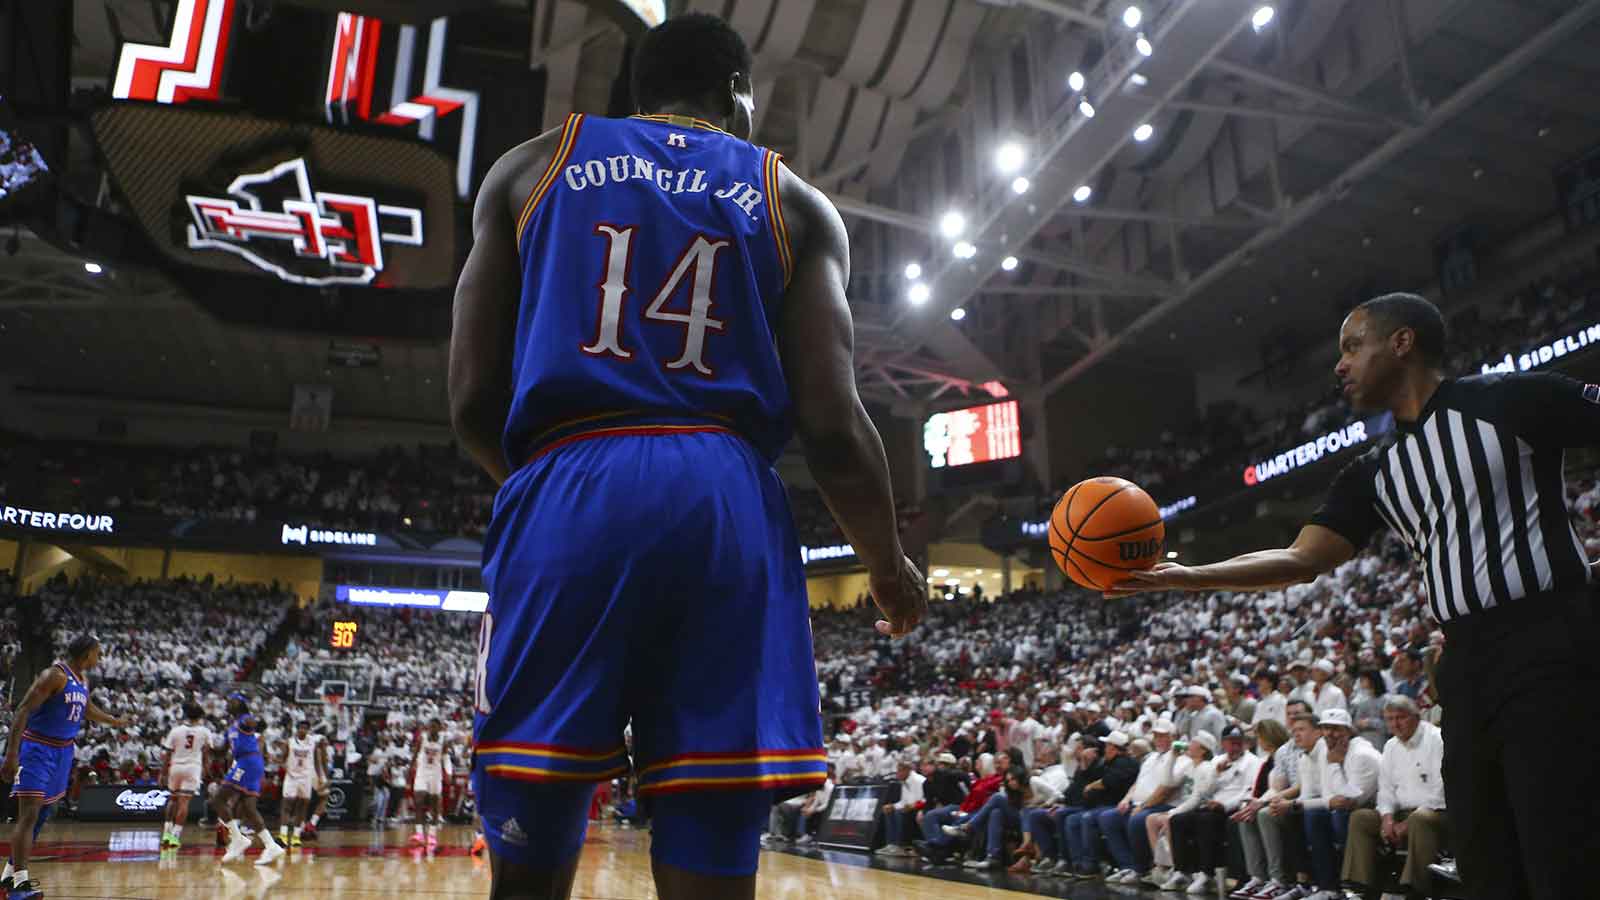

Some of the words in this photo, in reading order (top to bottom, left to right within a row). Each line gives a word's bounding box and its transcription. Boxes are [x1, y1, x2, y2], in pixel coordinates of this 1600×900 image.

[564, 154, 709, 192] COUNCIL
[714, 180, 763, 221] JR.
[581, 222, 732, 376] 14
[1243, 420, 1368, 486] QUARTERFOUR
[309, 529, 377, 546] SIDELINE
[67, 703, 82, 722] 13
[184, 734, 195, 750] 3
